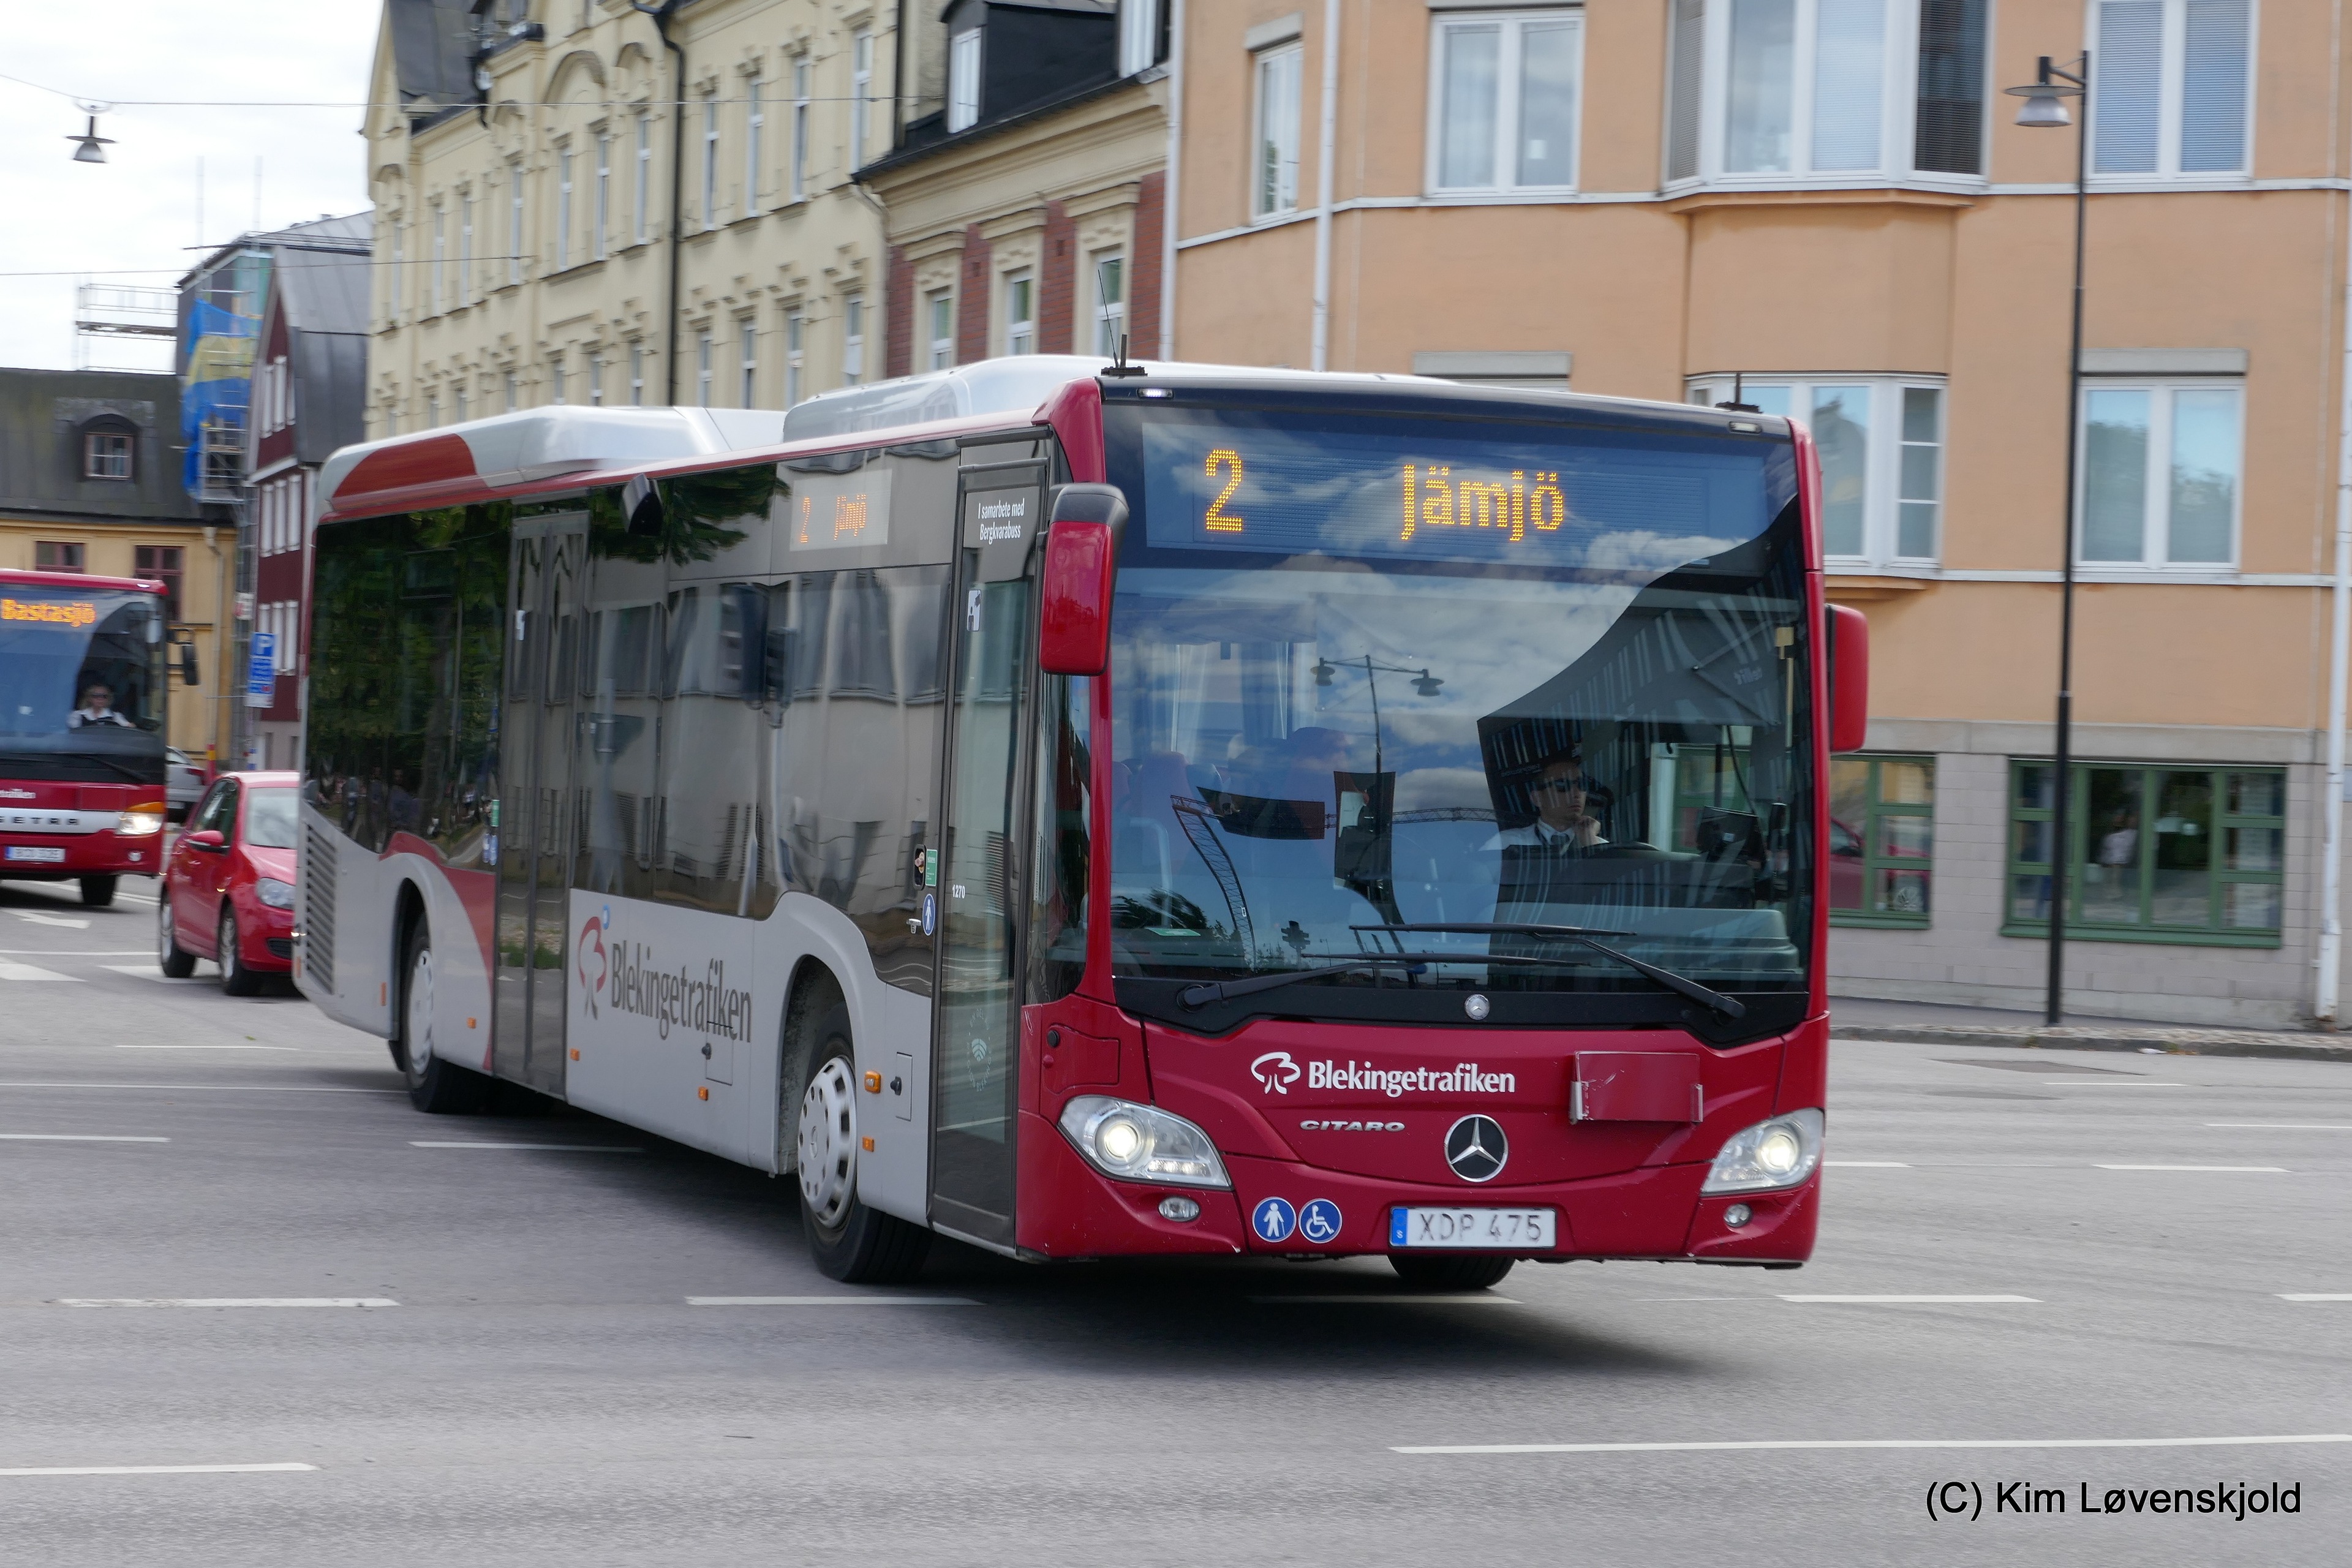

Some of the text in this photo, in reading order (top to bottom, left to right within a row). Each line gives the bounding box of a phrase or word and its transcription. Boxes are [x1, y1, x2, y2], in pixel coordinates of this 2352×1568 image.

[978, 497, 1025, 519] I samarbete med
[1205, 449, 1564, 541] 2 Jämjö
[800, 494, 867, 543] 2 Jämjö
[979, 520, 1021, 545] Bergkvarabuss
[1, 598, 96, 628] Bastasjö
[952, 884, 966, 899] 1270
[611, 939, 752, 1043] Blekingetrafiken
[1308, 1059, 1515, 1098] Blekingetrafiken
[1300, 1120, 1405, 1132] CITARO
[1396, 1213, 1542, 1243] S XDP 475
